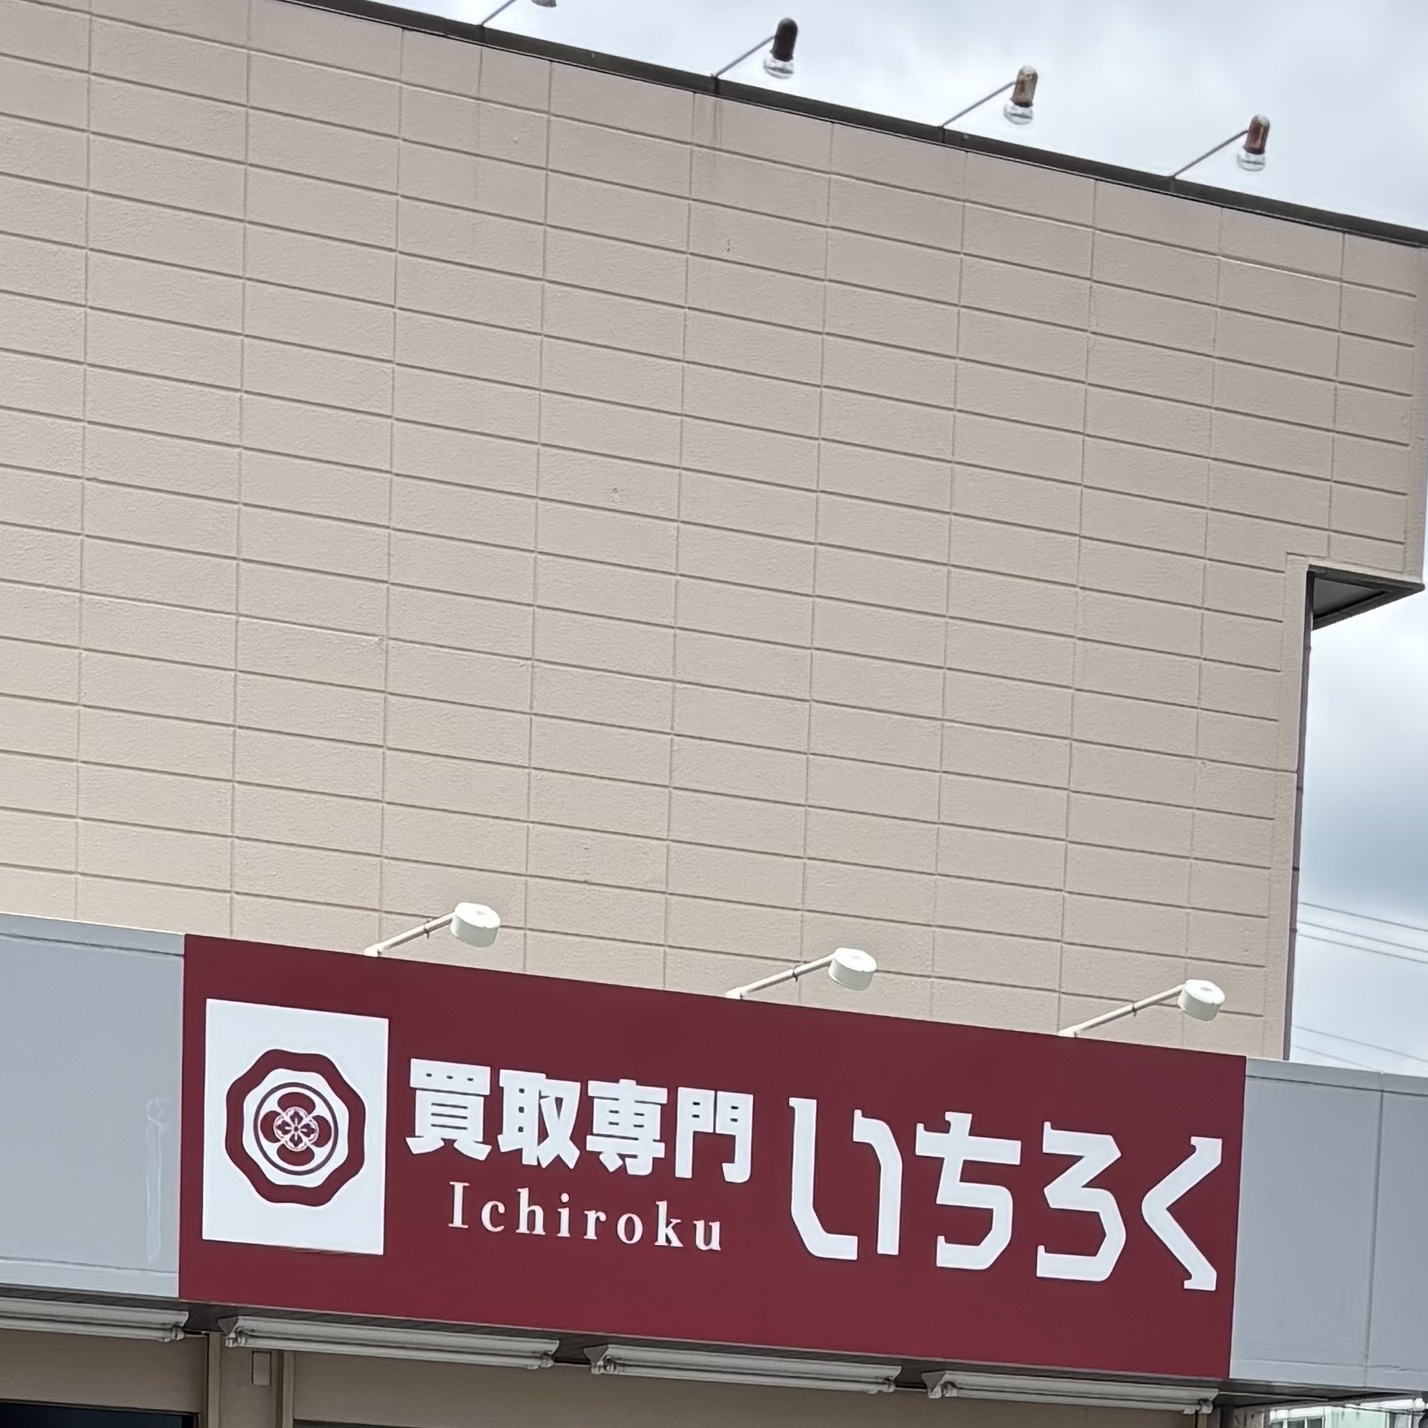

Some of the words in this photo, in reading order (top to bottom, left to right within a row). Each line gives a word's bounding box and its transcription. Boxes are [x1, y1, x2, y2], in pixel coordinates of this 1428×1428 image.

[405, 1057, 755, 1184] 買取専門
[447, 1181, 723, 1253] Ichiroku
[789, 1096, 1224, 1291] いちろく
